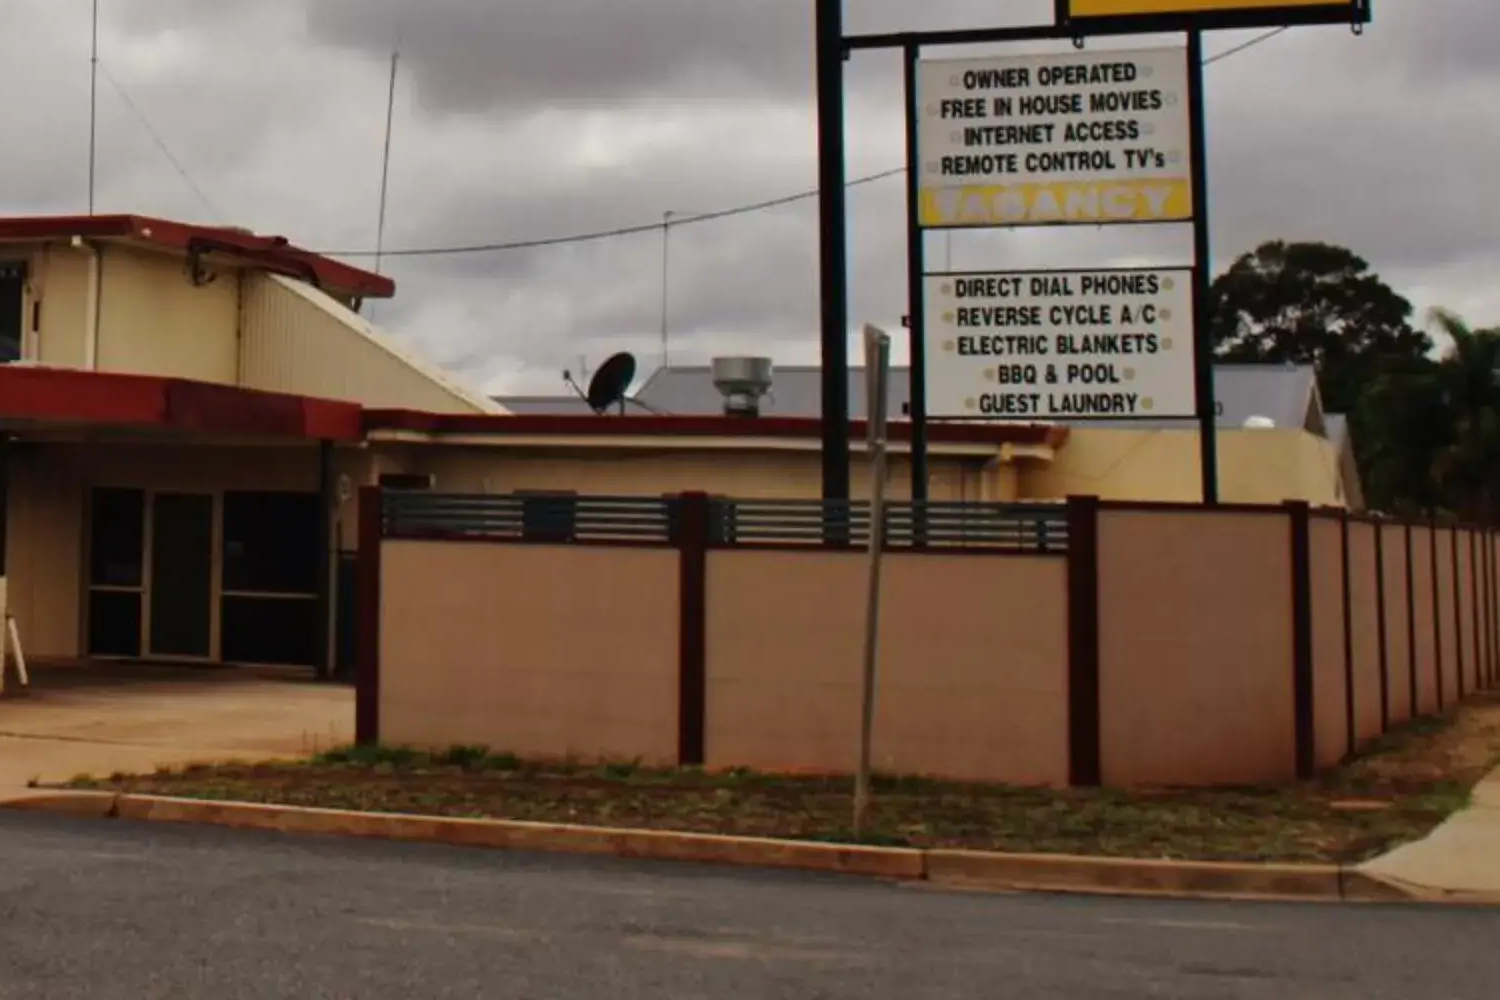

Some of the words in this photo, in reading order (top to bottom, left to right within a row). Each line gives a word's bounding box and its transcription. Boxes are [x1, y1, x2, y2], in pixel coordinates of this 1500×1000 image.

[963, 68, 1030, 90] OWNER
[1038, 62, 1136, 86] OPERATED
[940, 99, 986, 118] FREE
[994, 98, 1012, 116] IN
[1020, 94, 1082, 115] HOUSE
[1090, 90, 1162, 112] MOVIES
[964, 124, 1054, 146] INTERNET
[1064, 120, 1139, 142] ACCESS
[941, 154, 1018, 175] REMOTE
[1026, 150, 1116, 172] CONTROL
[1124, 148, 1164, 168] TV's
[955, 278, 1022, 298] DIRECT
[1030, 277, 1073, 296] DIAL
[1081, 274, 1158, 296] PHONES
[957, 306, 1041, 326] REVERSE
[1050, 304, 1110, 325] CYCLE
[958, 336, 1048, 356] ELECTRIC
[1056, 334, 1158, 354] BLANKETS
[998, 365, 1037, 384] BBQ
[1044, 365, 1058, 384] &
[1067, 364, 1120, 384] POOL
[980, 394, 1040, 414] GUEST
[1048, 394, 1138, 413] LAUNDRY
